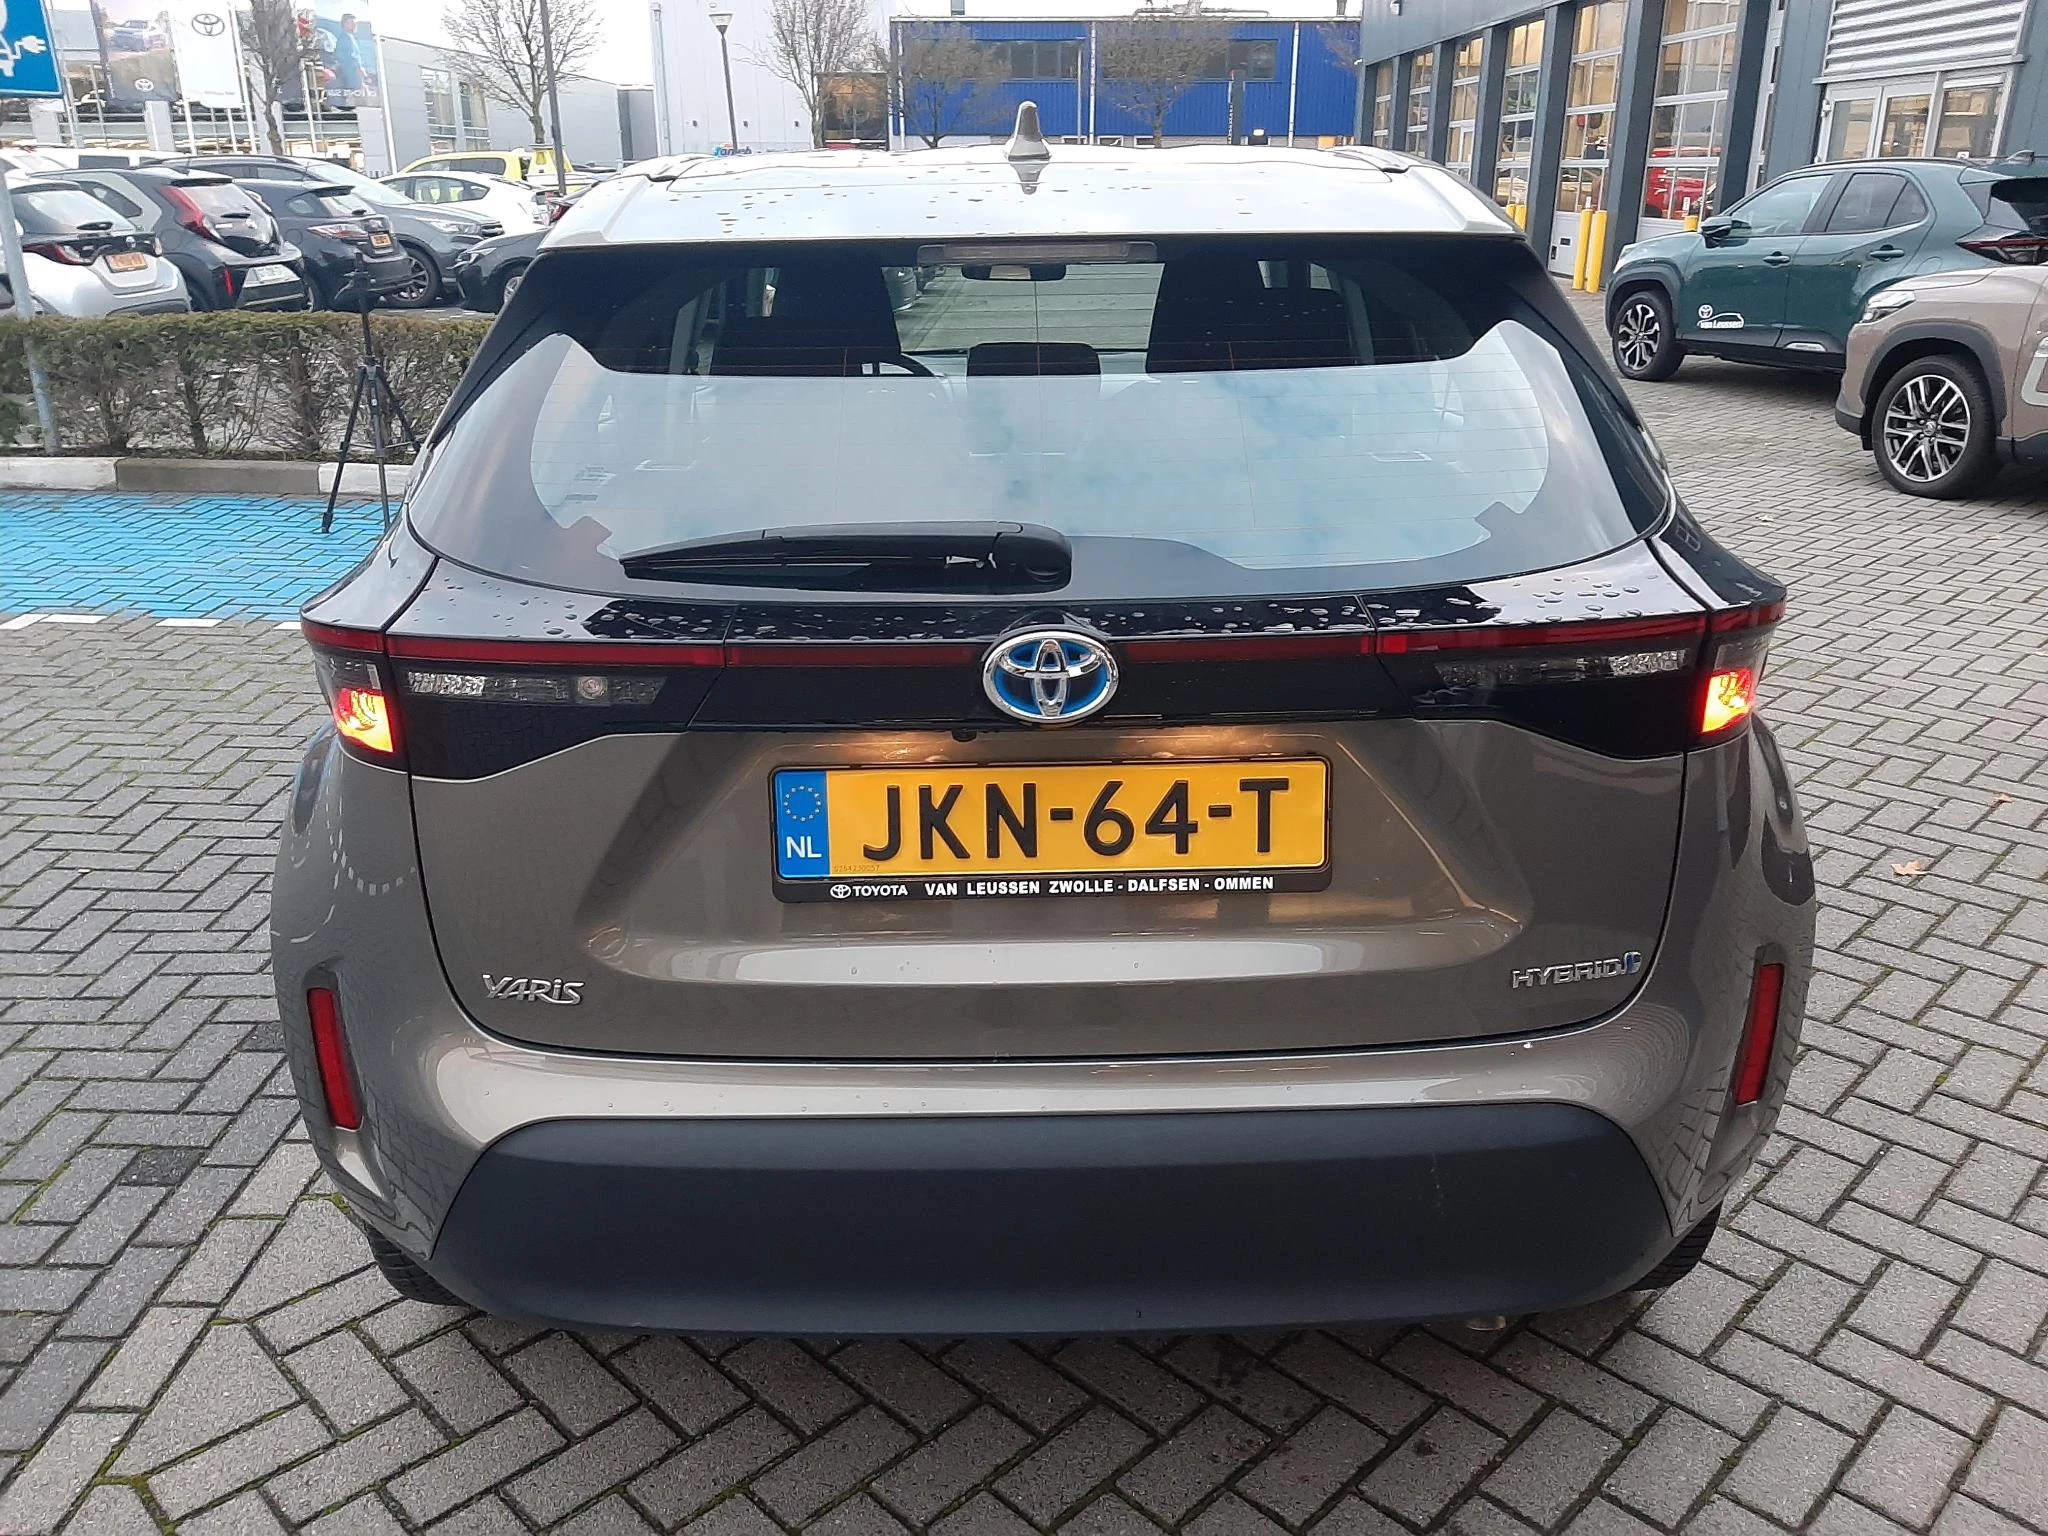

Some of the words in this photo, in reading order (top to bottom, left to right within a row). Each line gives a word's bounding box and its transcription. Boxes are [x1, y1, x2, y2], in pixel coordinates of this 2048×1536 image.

[862, 777, 1290, 861] JKN-64-T
[785, 835, 823, 859] NL
[852, 884, 908, 897] TOYOTA
[924, 882, 958, 896] VAN
[966, 880, 1041, 895] LEUSSEN
[1048, 878, 1114, 894] ZWOLLE
[1127, 877, 1200, 892] DALFSEN
[1213, 876, 1274, 890] OMMEN
[1512, 958, 1623, 989] HYBRID
